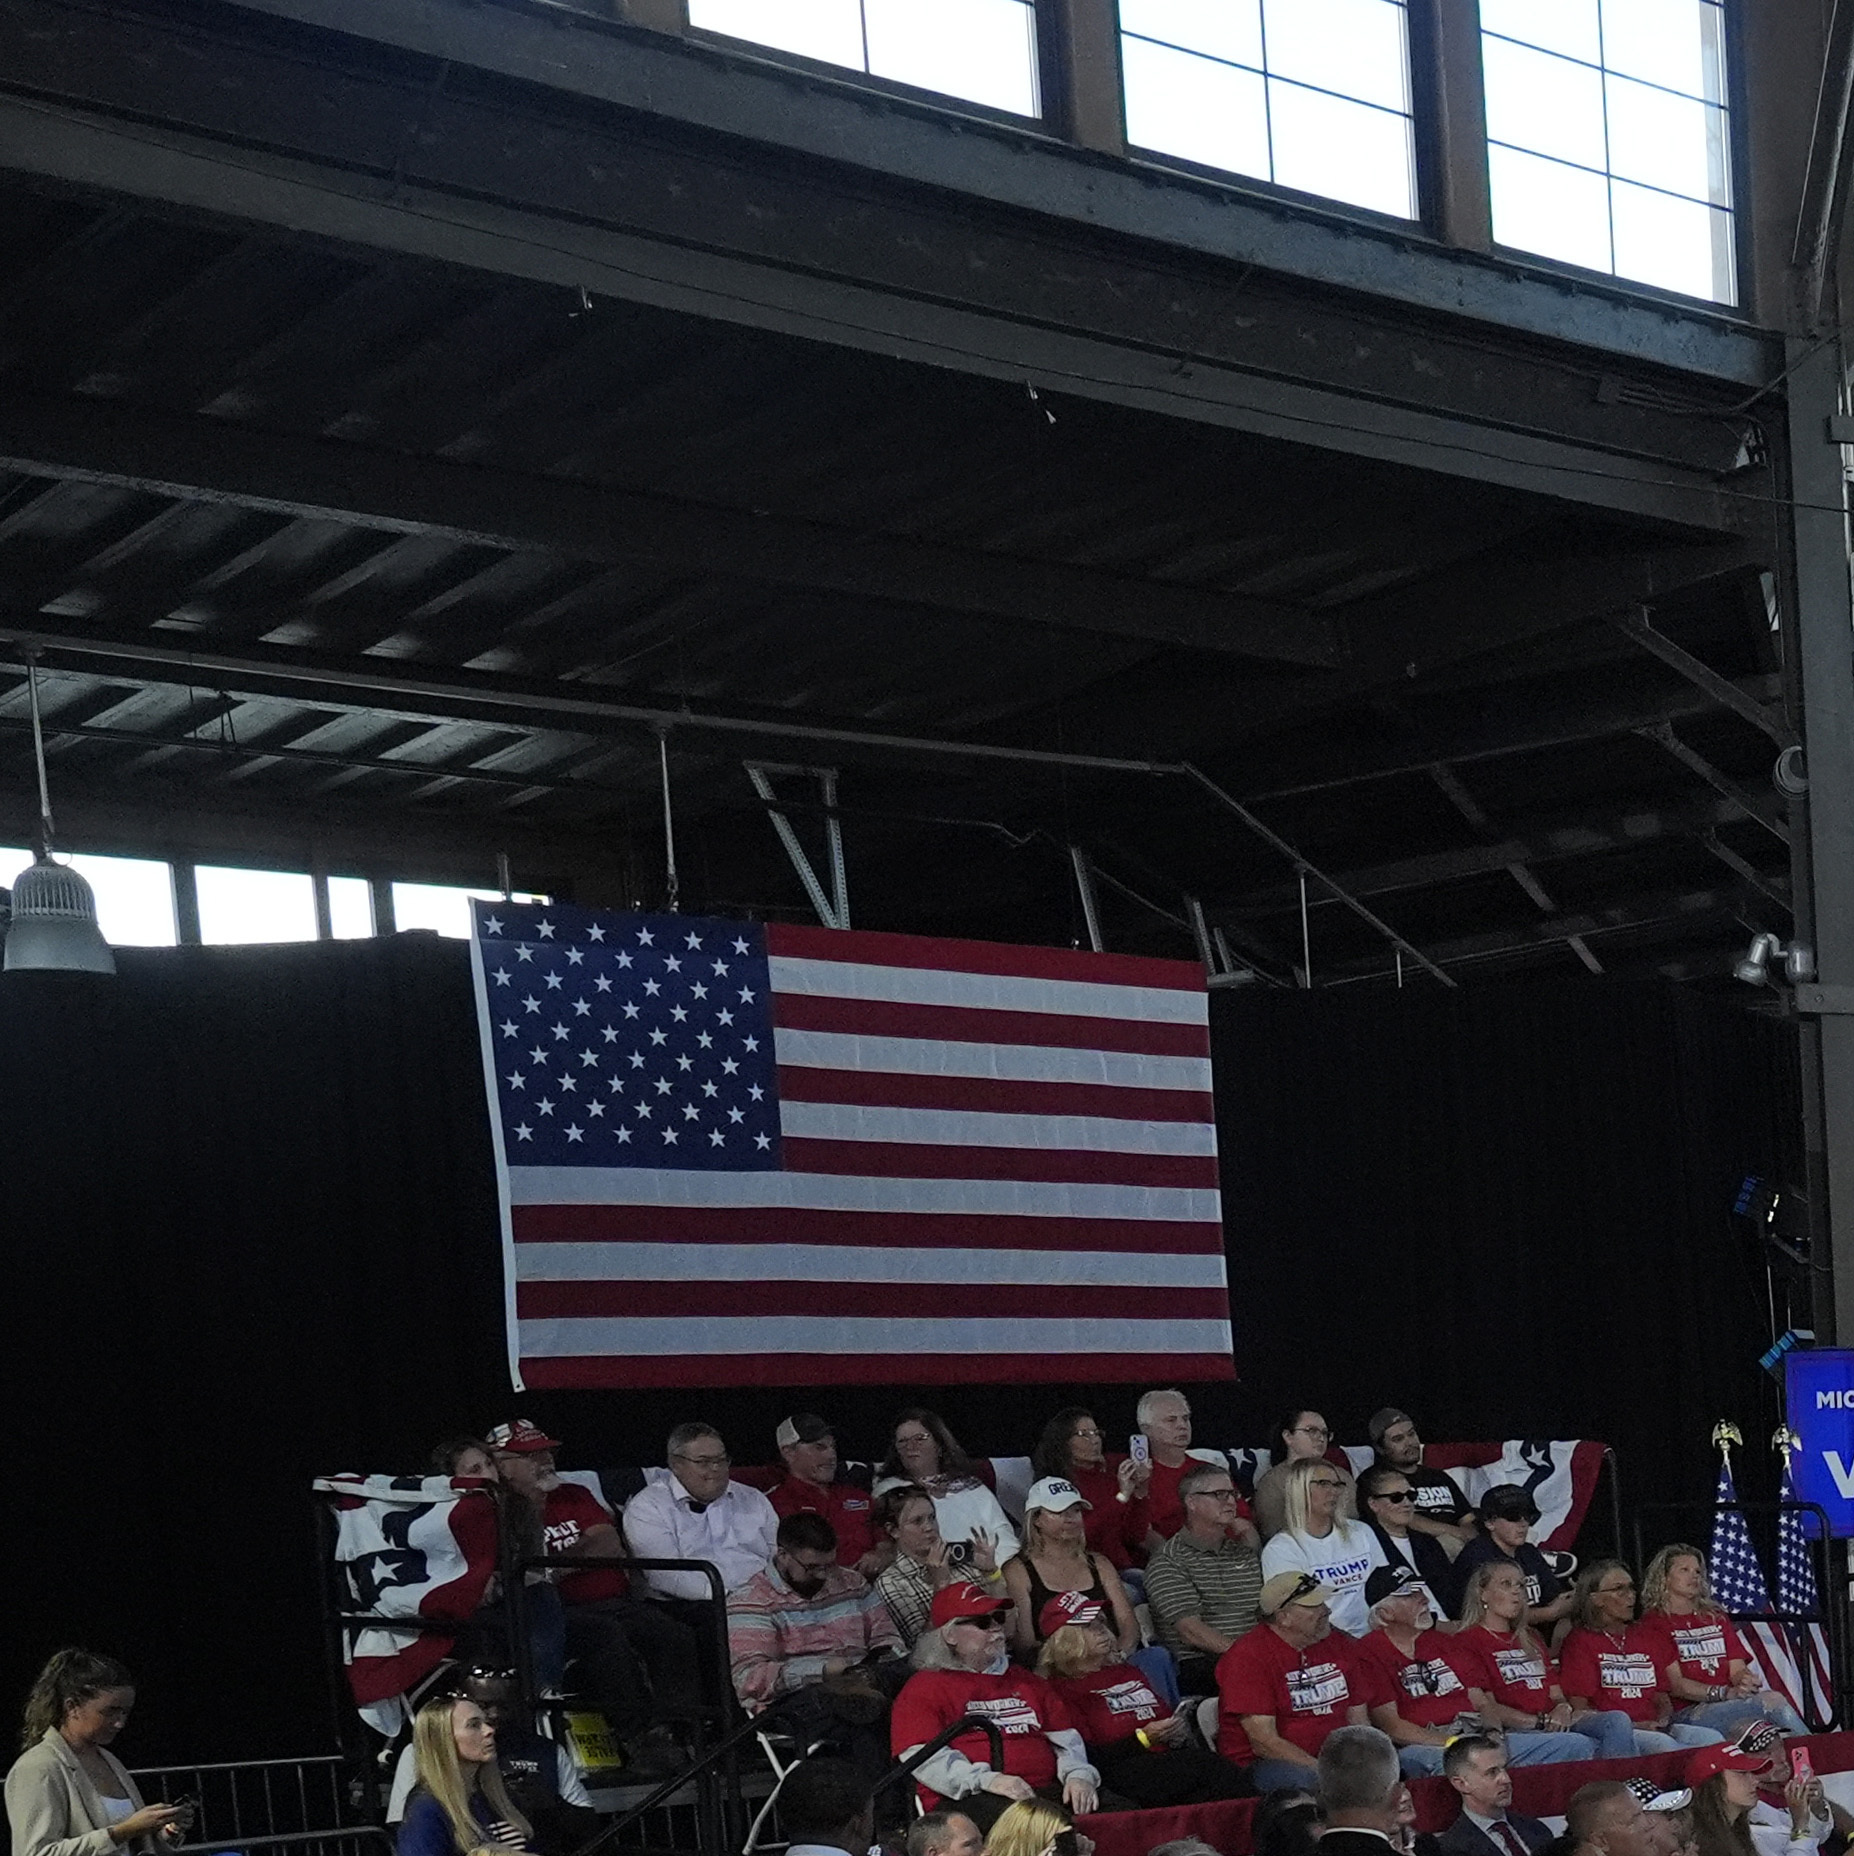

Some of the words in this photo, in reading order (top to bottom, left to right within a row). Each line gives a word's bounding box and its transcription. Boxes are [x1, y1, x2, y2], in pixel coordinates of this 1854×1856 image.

[1315, 1558, 1369, 1580] TRUMP
[1333, 1573, 1363, 1586] VANCE
[1603, 1669, 1656, 1685] TRUMP
[1292, 1681, 1349, 1705] TRUMP
[1621, 1687, 1642, 1698] 2024
[1136, 1707, 1157, 1721] 2024
